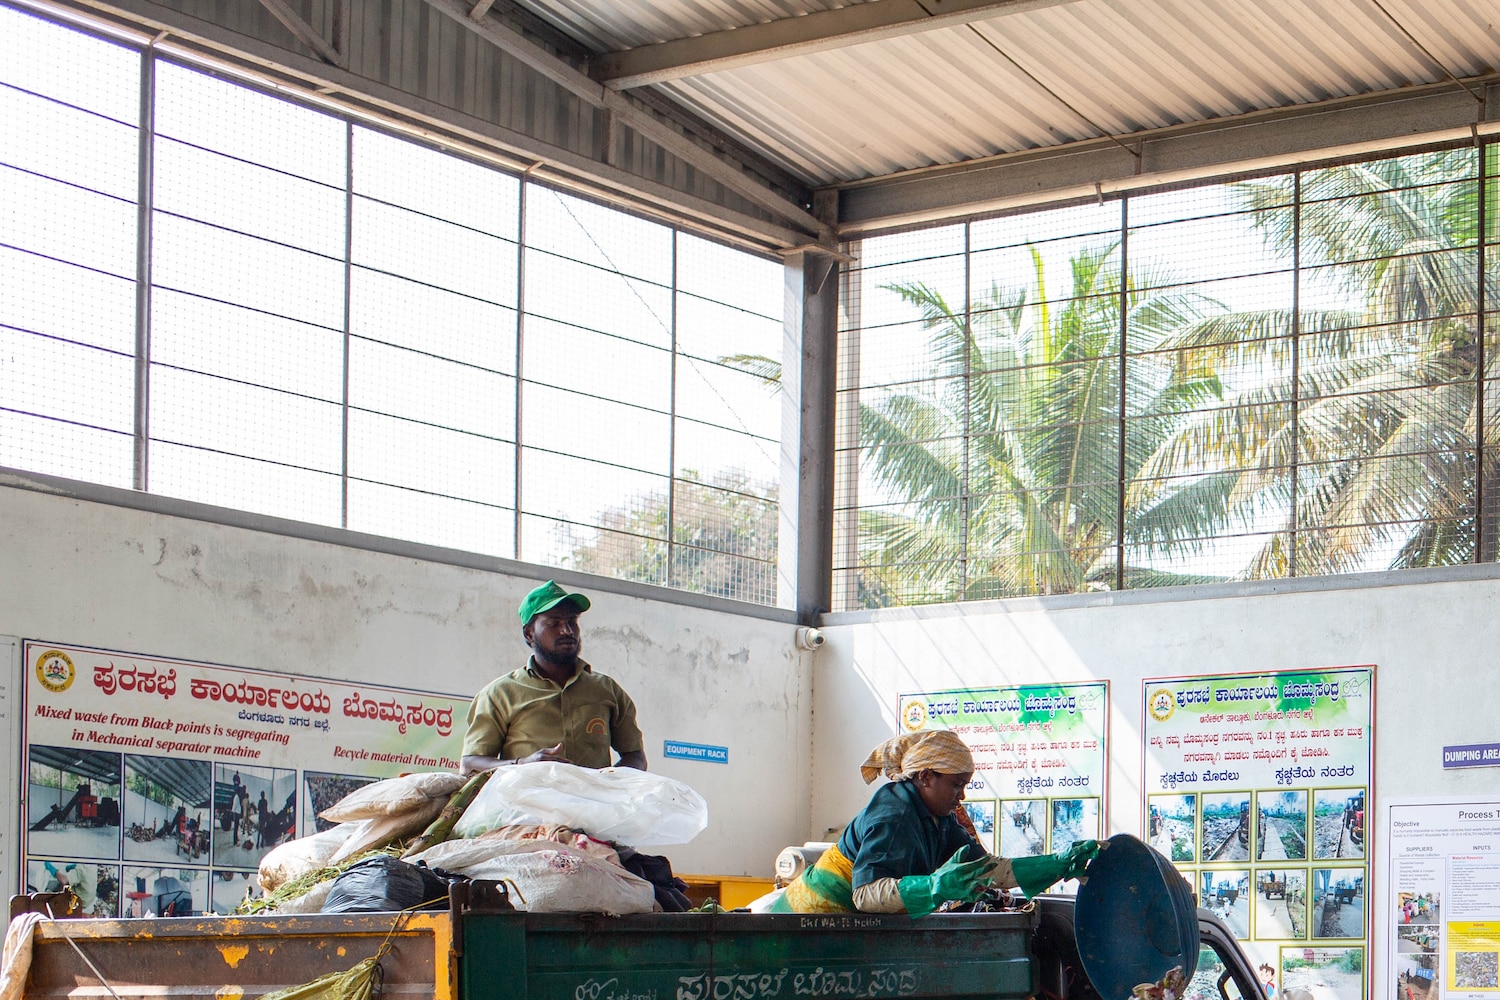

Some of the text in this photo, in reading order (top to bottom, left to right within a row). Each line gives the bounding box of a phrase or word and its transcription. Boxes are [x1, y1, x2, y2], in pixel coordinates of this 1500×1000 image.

[93, 660, 453, 737] ಪುರಸಭೆ ಕಾರ್ಯಾಲಯ ಬೊಮ್ಮಸಂದ್ರ
[927, 698, 959, 719] ಪುರಸಭೆ
[963, 698, 1021, 714] ಕಾರ್ಯಾಲಯ
[1025, 692, 1077, 718] ಬೊಮ್ಮಸಂದ್ರ
[1176, 686, 1211, 709] ಪುರಸಭೆ
[1215, 685, 1279, 702] ಕಾರ್ಯಾಲಯ
[1283, 679, 1340, 705] ಬೊಮ್ಮಸಂದ್ರ
[34, 704, 290, 746] Mixed waste from Black points is segregating
[238, 709, 285, 725] ಬೆಂಗಳೂರು
[289, 715, 311, 727] ನಗರ
[71, 729, 261, 759] in Mechanical separator machine
[666, 745, 726, 759] EQUIPMENT RACK
[1444, 749, 1481, 762] DUMPING
[333, 745, 460, 769] Recycle material from Plas
[1058, 774, 1090, 787] ನಂತರ
[1159, 764, 1355, 789] ಸ್ವಚ್ಛತೆಯ ಮೊದಲು ಸ್ವಚ್ಛತೆಯ ನಂತರ
[1393, 820, 1420, 828] Objective
[1458, 809, 1494, 820] Process
